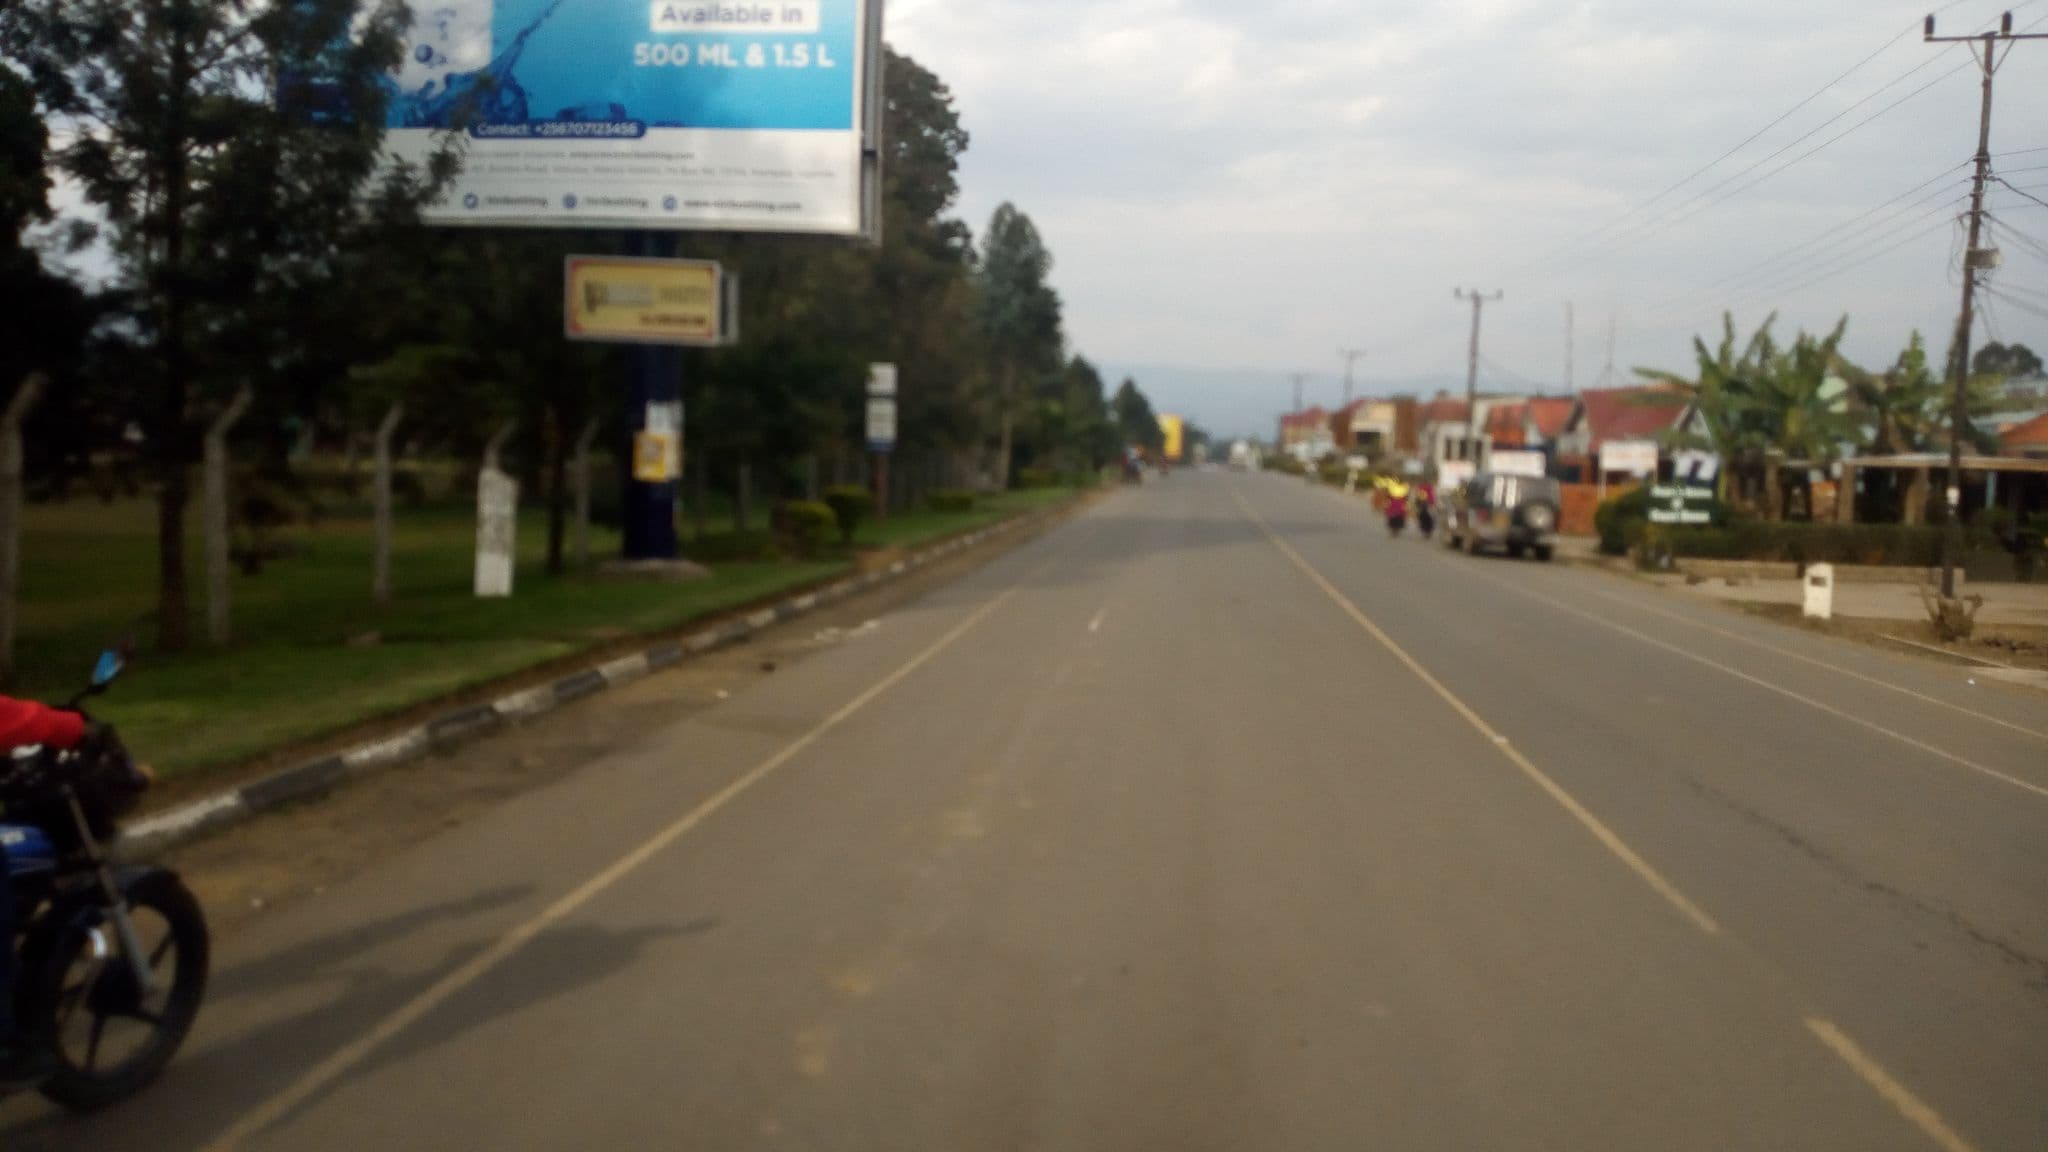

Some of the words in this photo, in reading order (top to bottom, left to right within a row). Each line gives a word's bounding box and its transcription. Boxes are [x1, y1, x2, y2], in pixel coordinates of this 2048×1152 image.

[662, 5, 772, 22] Available
[782, 5, 803, 22] in
[634, 43, 689, 67] 500
[698, 43, 737, 67] ML
[745, 43, 765, 67] &
[774, 43, 809, 67] 1.5
[817, 43, 836, 67] L
